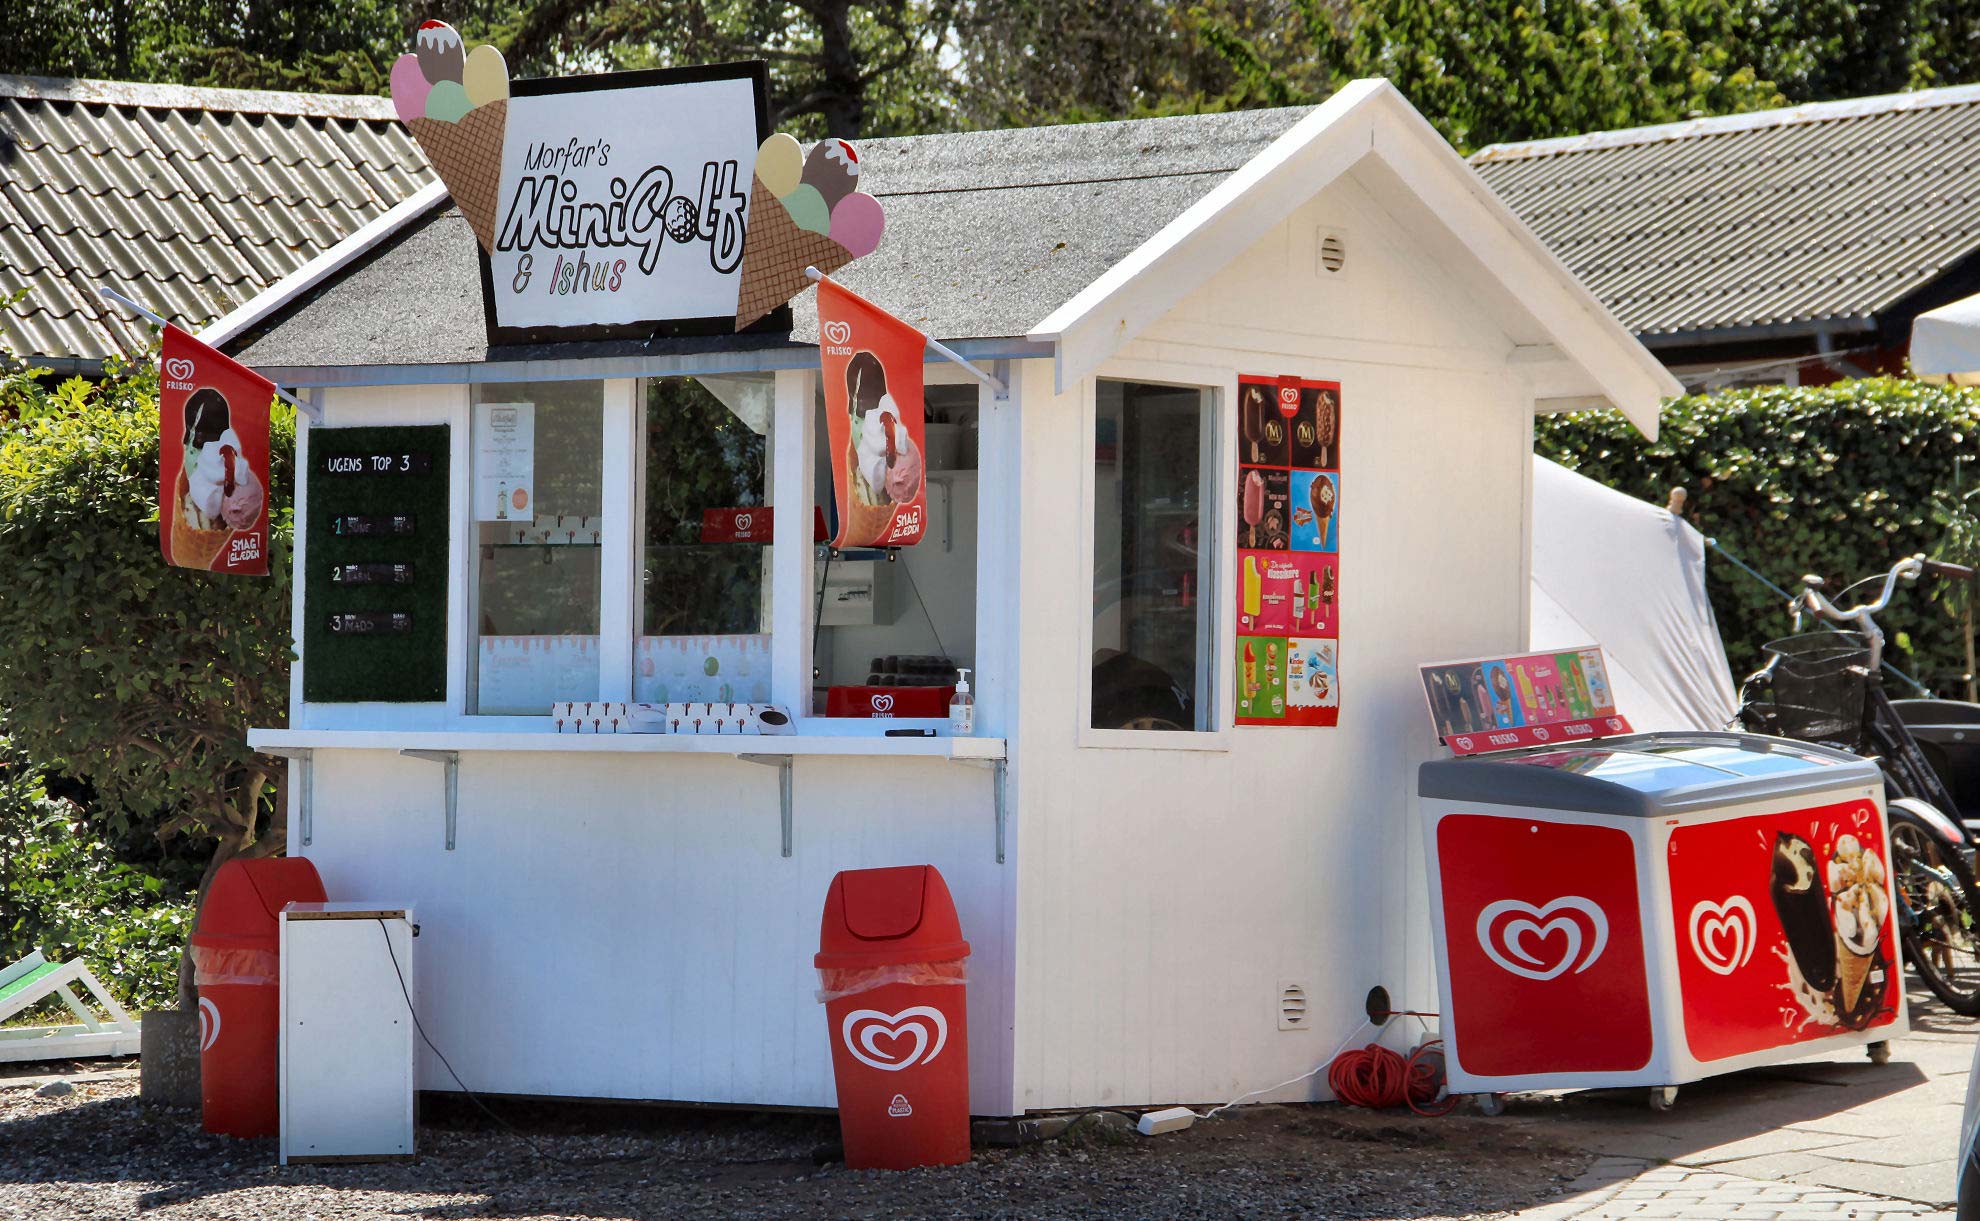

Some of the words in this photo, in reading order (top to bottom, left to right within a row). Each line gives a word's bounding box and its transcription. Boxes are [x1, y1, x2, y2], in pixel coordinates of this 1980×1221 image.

[524, 136, 611, 176] Morfar's
[512, 252, 534, 294] &
[549, 250, 627, 296] Ishus
[827, 346, 852, 356] FRISKO
[166, 380, 194, 391] FRISKO
[328, 457, 362, 472] UGENS
[371, 455, 392, 471] TOP
[400, 454, 410, 472] 3
[335, 517, 342, 535] 1
[896, 512, 919, 527] SMAG
[231, 538, 257, 552] SMAG
[333, 566, 342, 581] 2
[332, 615, 341, 631] 3
[1489, 733, 1519, 746] FRISKO
[1564, 723, 1593, 736] FRISKO
